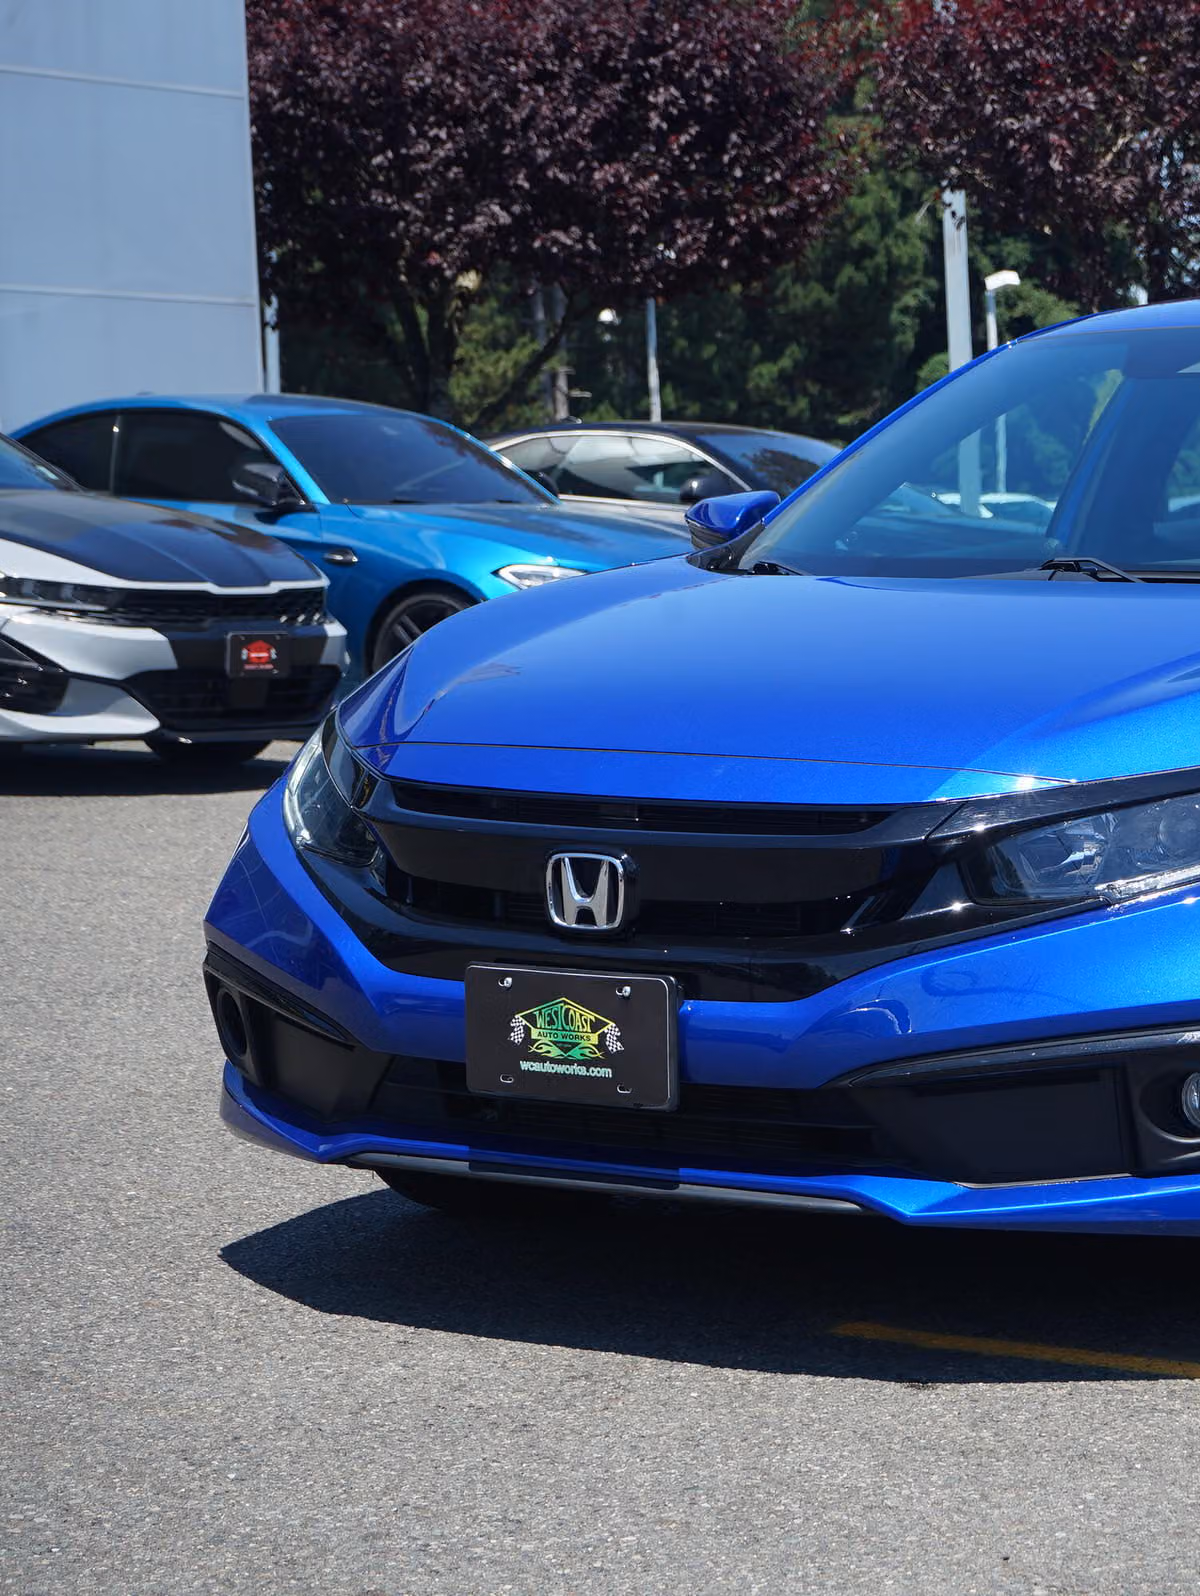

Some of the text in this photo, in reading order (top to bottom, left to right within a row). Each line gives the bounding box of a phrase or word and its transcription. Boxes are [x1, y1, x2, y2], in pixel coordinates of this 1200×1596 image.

[537, 1031, 592, 1042] AUTO WORKS
[519, 1060, 613, 1078] wcautoworks.com
